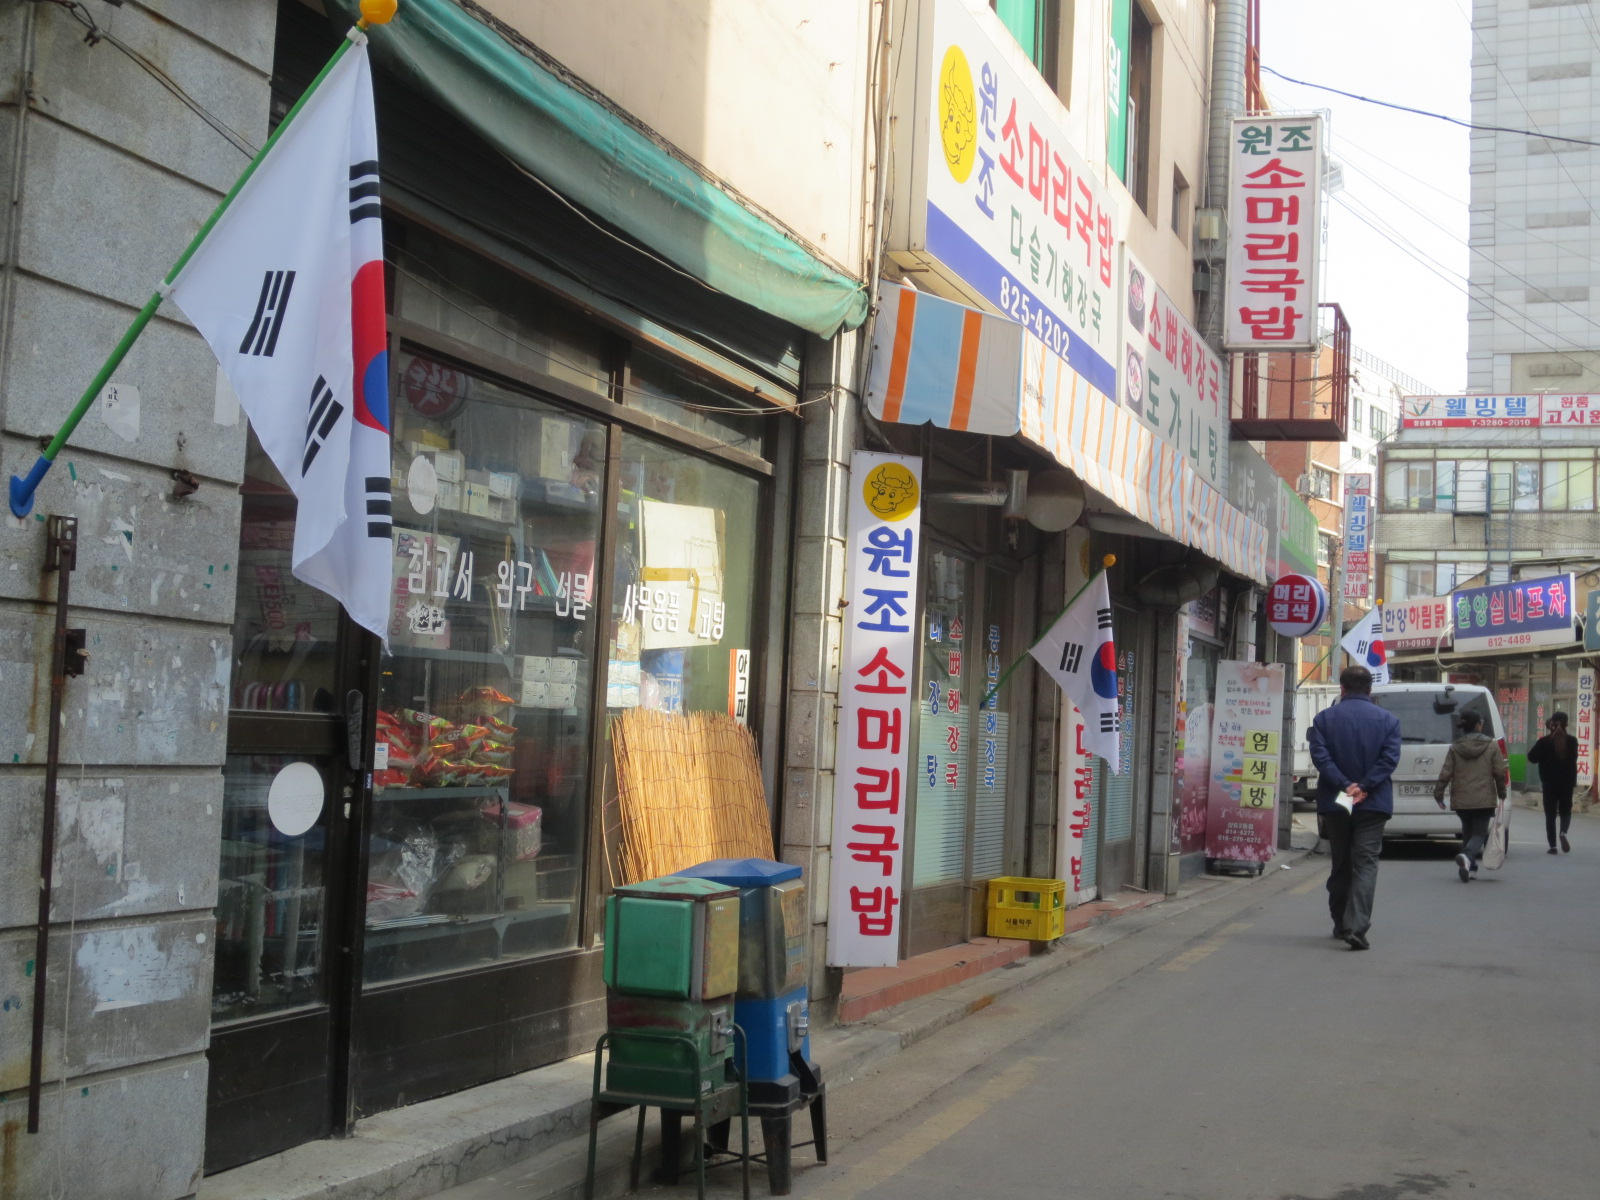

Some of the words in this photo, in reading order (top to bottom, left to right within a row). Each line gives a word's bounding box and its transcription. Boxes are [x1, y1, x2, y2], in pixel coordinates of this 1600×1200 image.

[975, 61, 998, 221] 원조
[1237, 125, 1313, 156] 원조
[1000, 98, 1113, 288] 소머리국밥
[1010, 205, 1101, 344] 다슬기해장국
[1239, 158, 1306, 340] 소머리국밥
[1000, 276, 1070, 362] 825-4202
[1148, 291, 1219, 417] 소뼈해장국
[1146, 368, 1219, 481] 도가니탕
[1445, 397, 1527, 417] 웰빙텔
[1560, 396, 1589, 408] 원룸
[408, 541, 474, 602] 참고서
[496, 560, 533, 610] 완구
[555, 571, 589, 620] 선물
[623, 584, 680, 633] 사무용품
[699, 598, 726, 640] 코팅
[857, 526, 913, 634] 원조
[1273, 584, 1310, 601] 머리
[1273, 603, 1310, 620] 염색
[1385, 607, 1408, 634] 한양
[1408, 603, 1446, 630] 하림닭
[1456, 594, 1488, 629] 한양
[1490, 581, 1567, 625] 실내포차
[1488, 635, 1531, 647] 812-4489
[927, 610, 943, 788] 내장탕
[945, 615, 963, 790] 소뼈해장국
[984, 625, 1000, 793] 콩나물해장국
[1578, 675, 1592, 707] 한양
[1577, 709, 1592, 775] 실내포차
[846, 646, 906, 937] 소머리국밥
